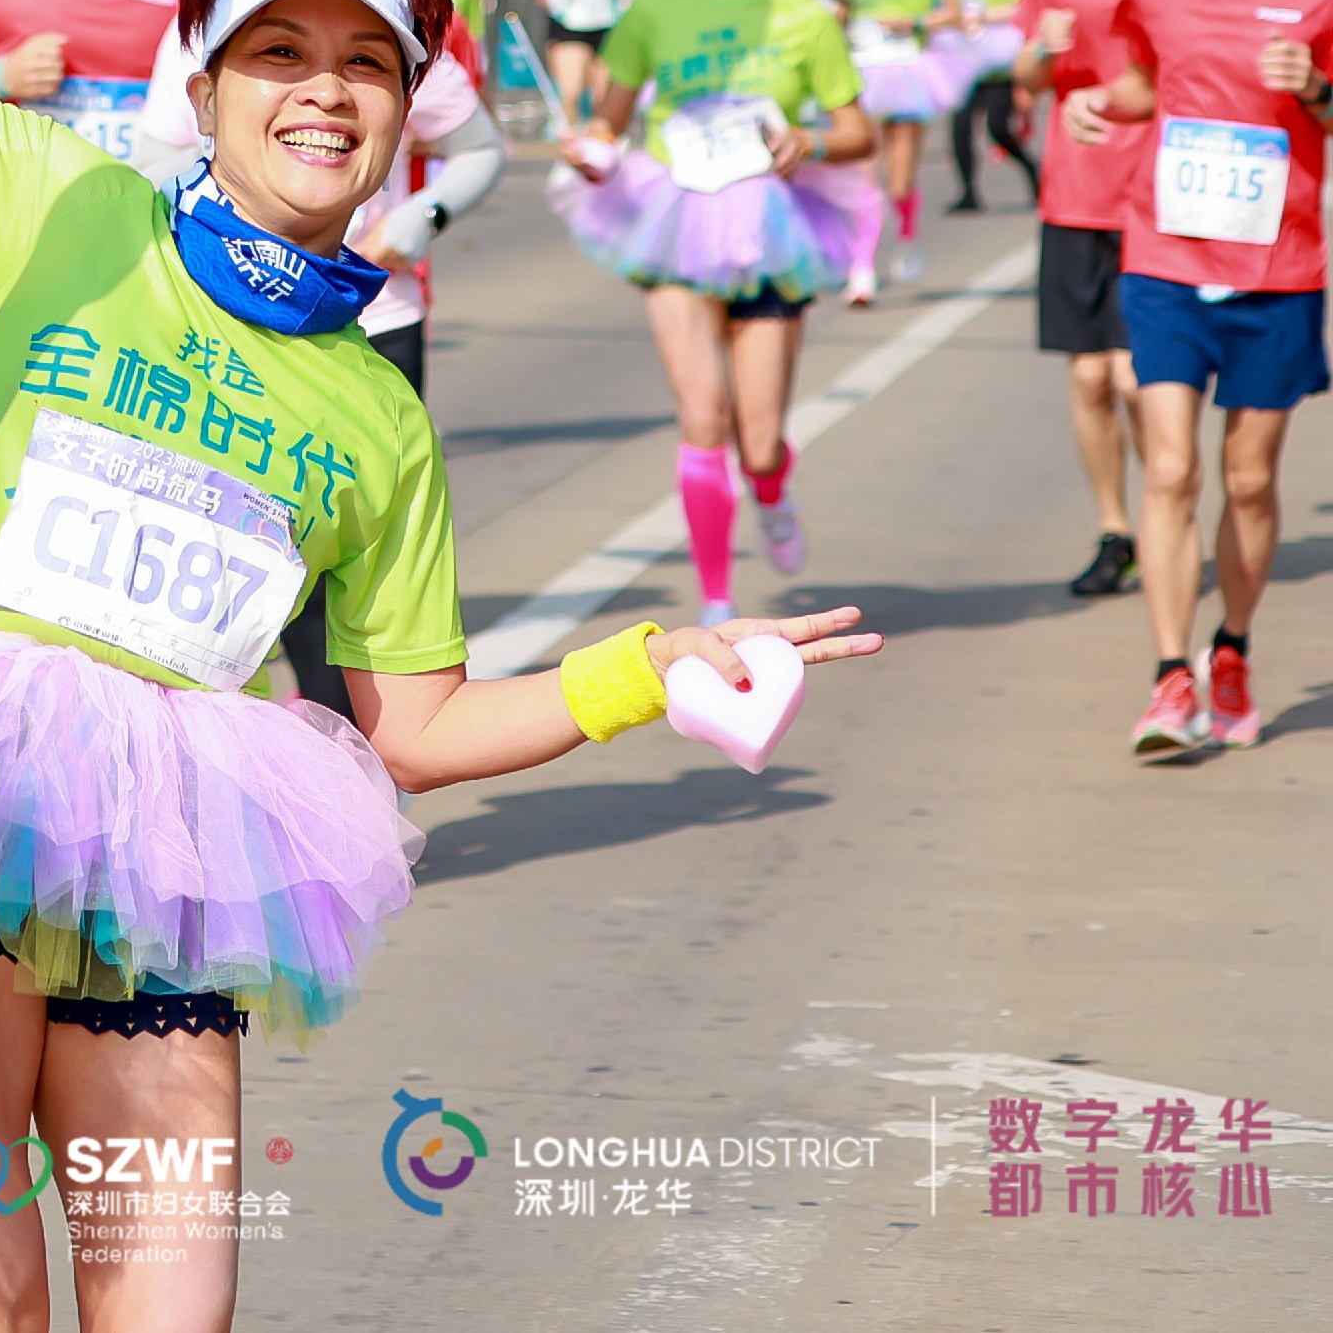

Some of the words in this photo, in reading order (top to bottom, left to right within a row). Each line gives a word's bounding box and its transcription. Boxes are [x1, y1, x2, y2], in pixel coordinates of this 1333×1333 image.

[175, 325, 265, 397] 我是
[20, 324, 357, 519] 全棉时代
[48, 433, 223, 517] 女子时尚微马
[33, 495, 269, 635] C1687
